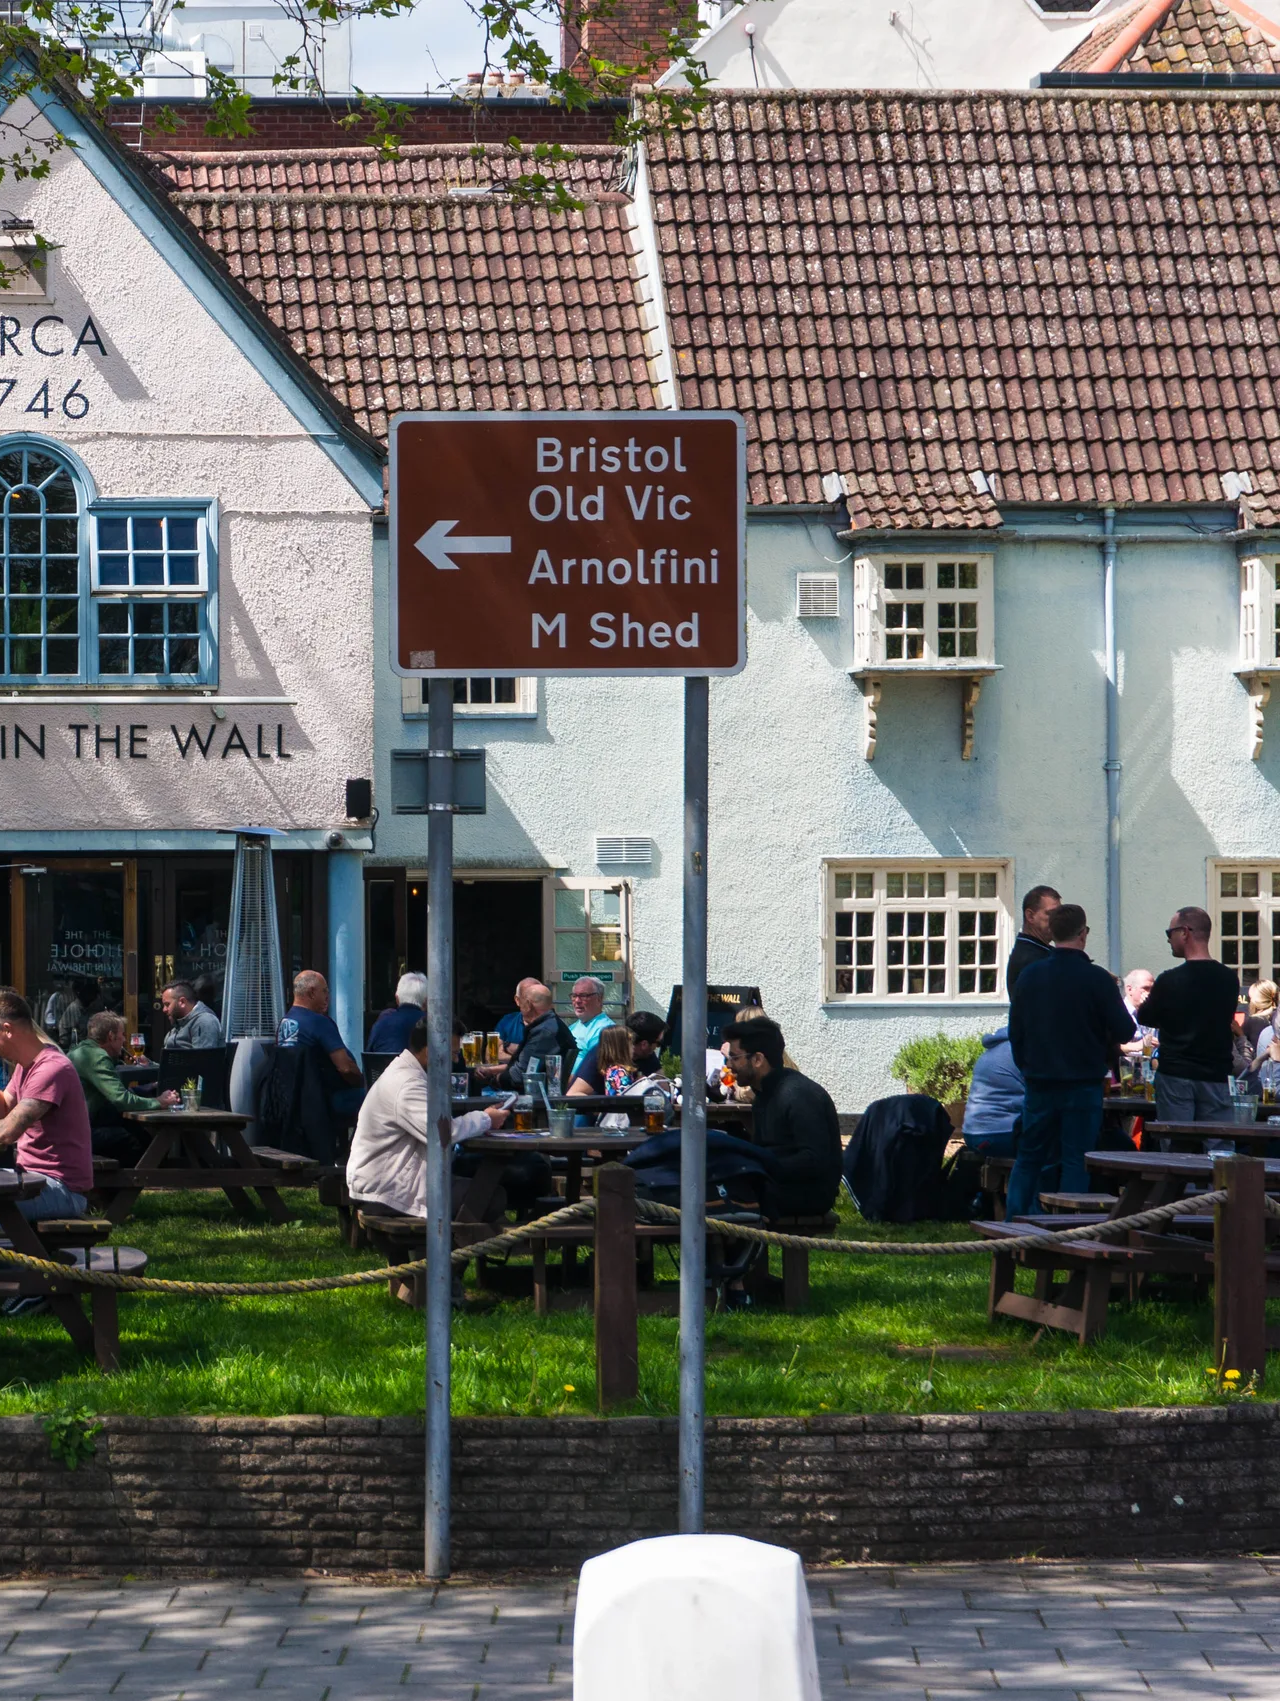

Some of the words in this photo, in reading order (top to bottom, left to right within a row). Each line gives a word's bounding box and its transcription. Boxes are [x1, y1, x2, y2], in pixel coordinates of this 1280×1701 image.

[537, 436, 687, 473] Bristol
[529, 485, 604, 522] Old
[624, 485, 691, 521] Vic
[528, 548, 718, 585] Arnolfini
[531, 613, 566, 648] M
[589, 612, 699, 649] Shed
[0, 723, 46, 760] IN
[68, 723, 148, 760] THE
[170, 723, 292, 760] WALL
[721, 993, 741, 1004] WALL
